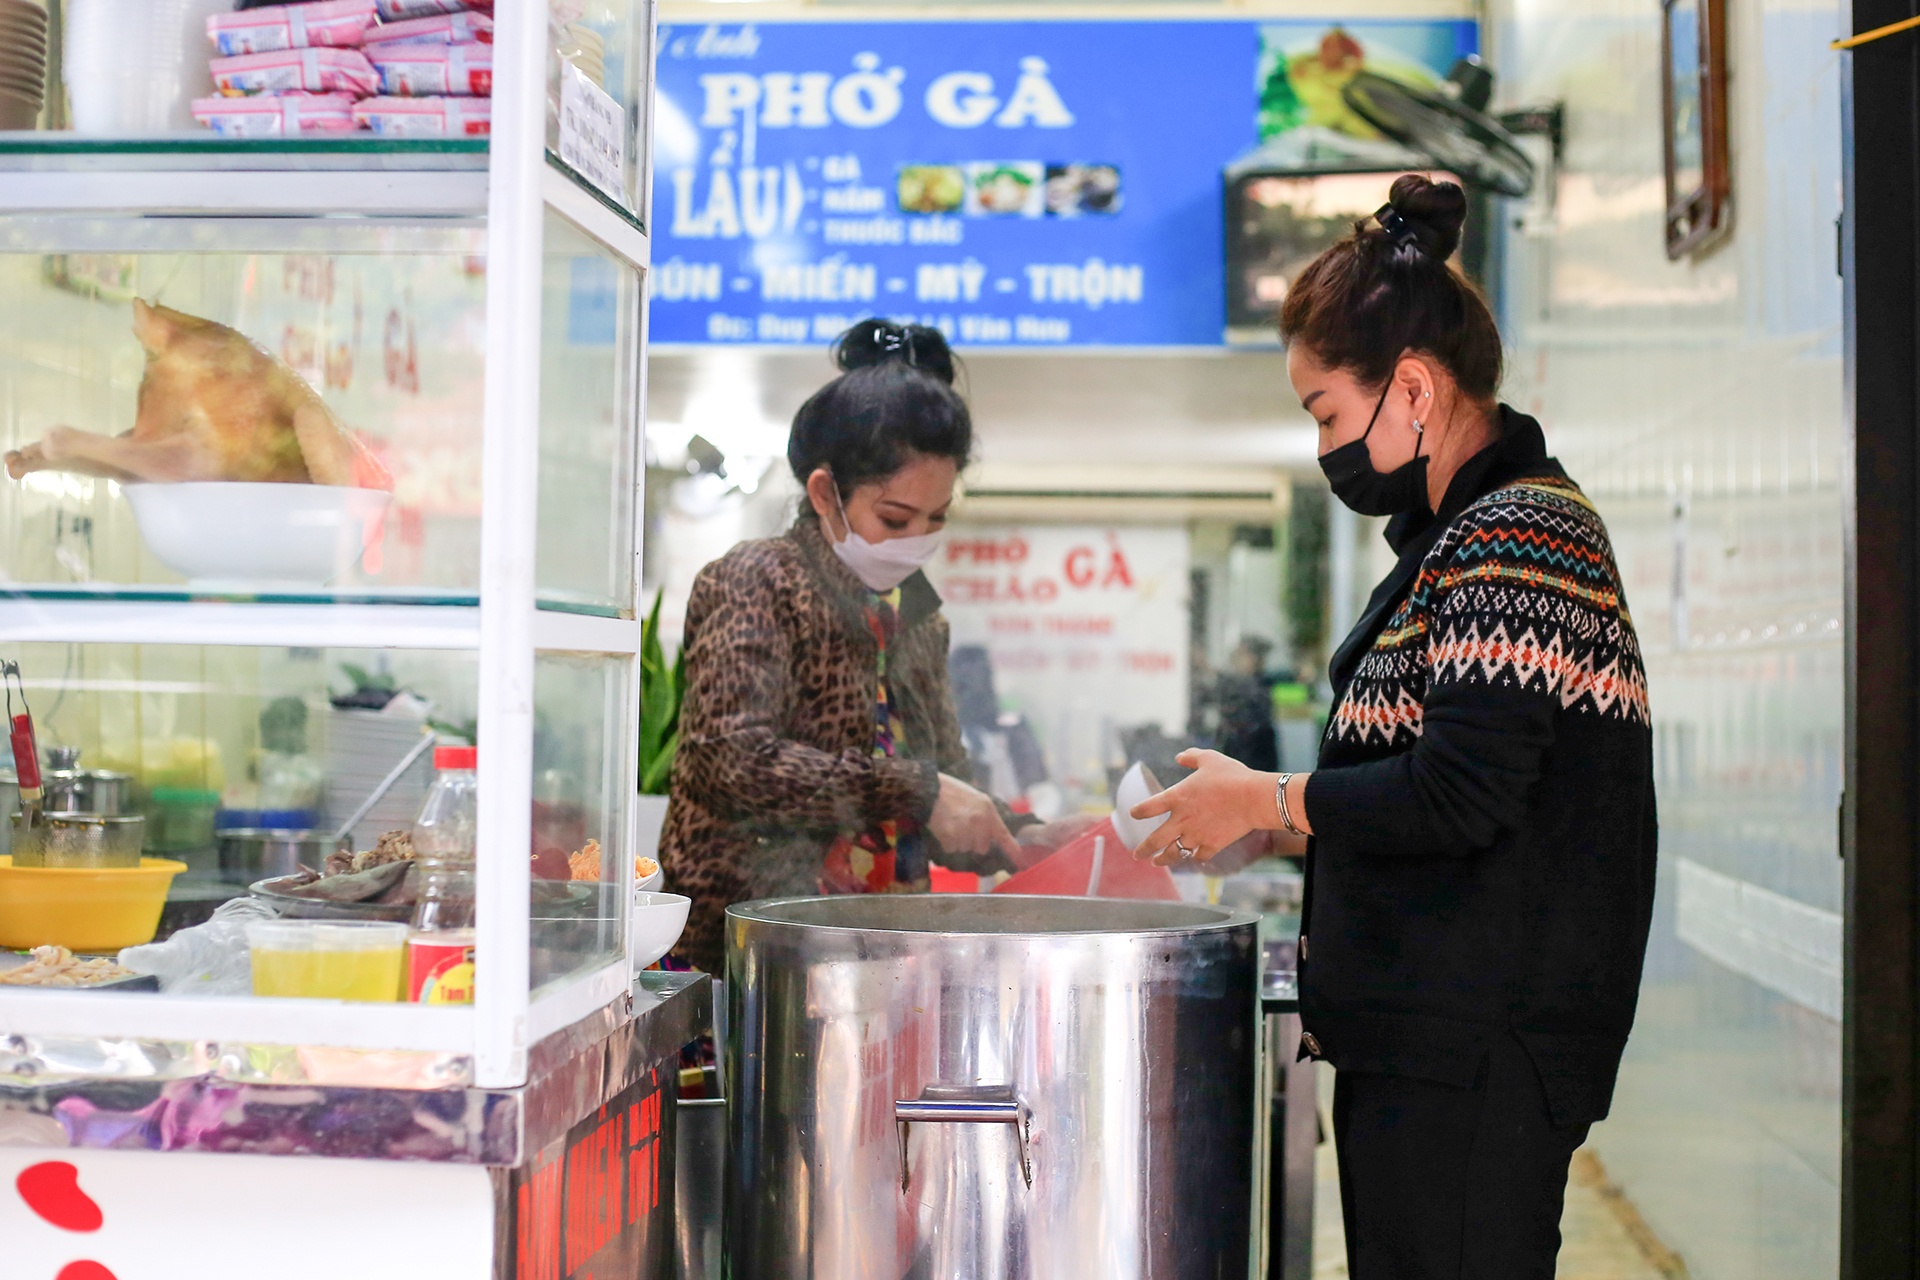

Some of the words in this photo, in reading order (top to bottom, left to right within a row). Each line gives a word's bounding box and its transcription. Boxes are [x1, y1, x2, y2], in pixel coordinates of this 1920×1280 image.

[700, 52, 906, 129] PHỞ
[925, 56, 1075, 129] GÀ
[1024, 256, 1144, 310] TRỘN
